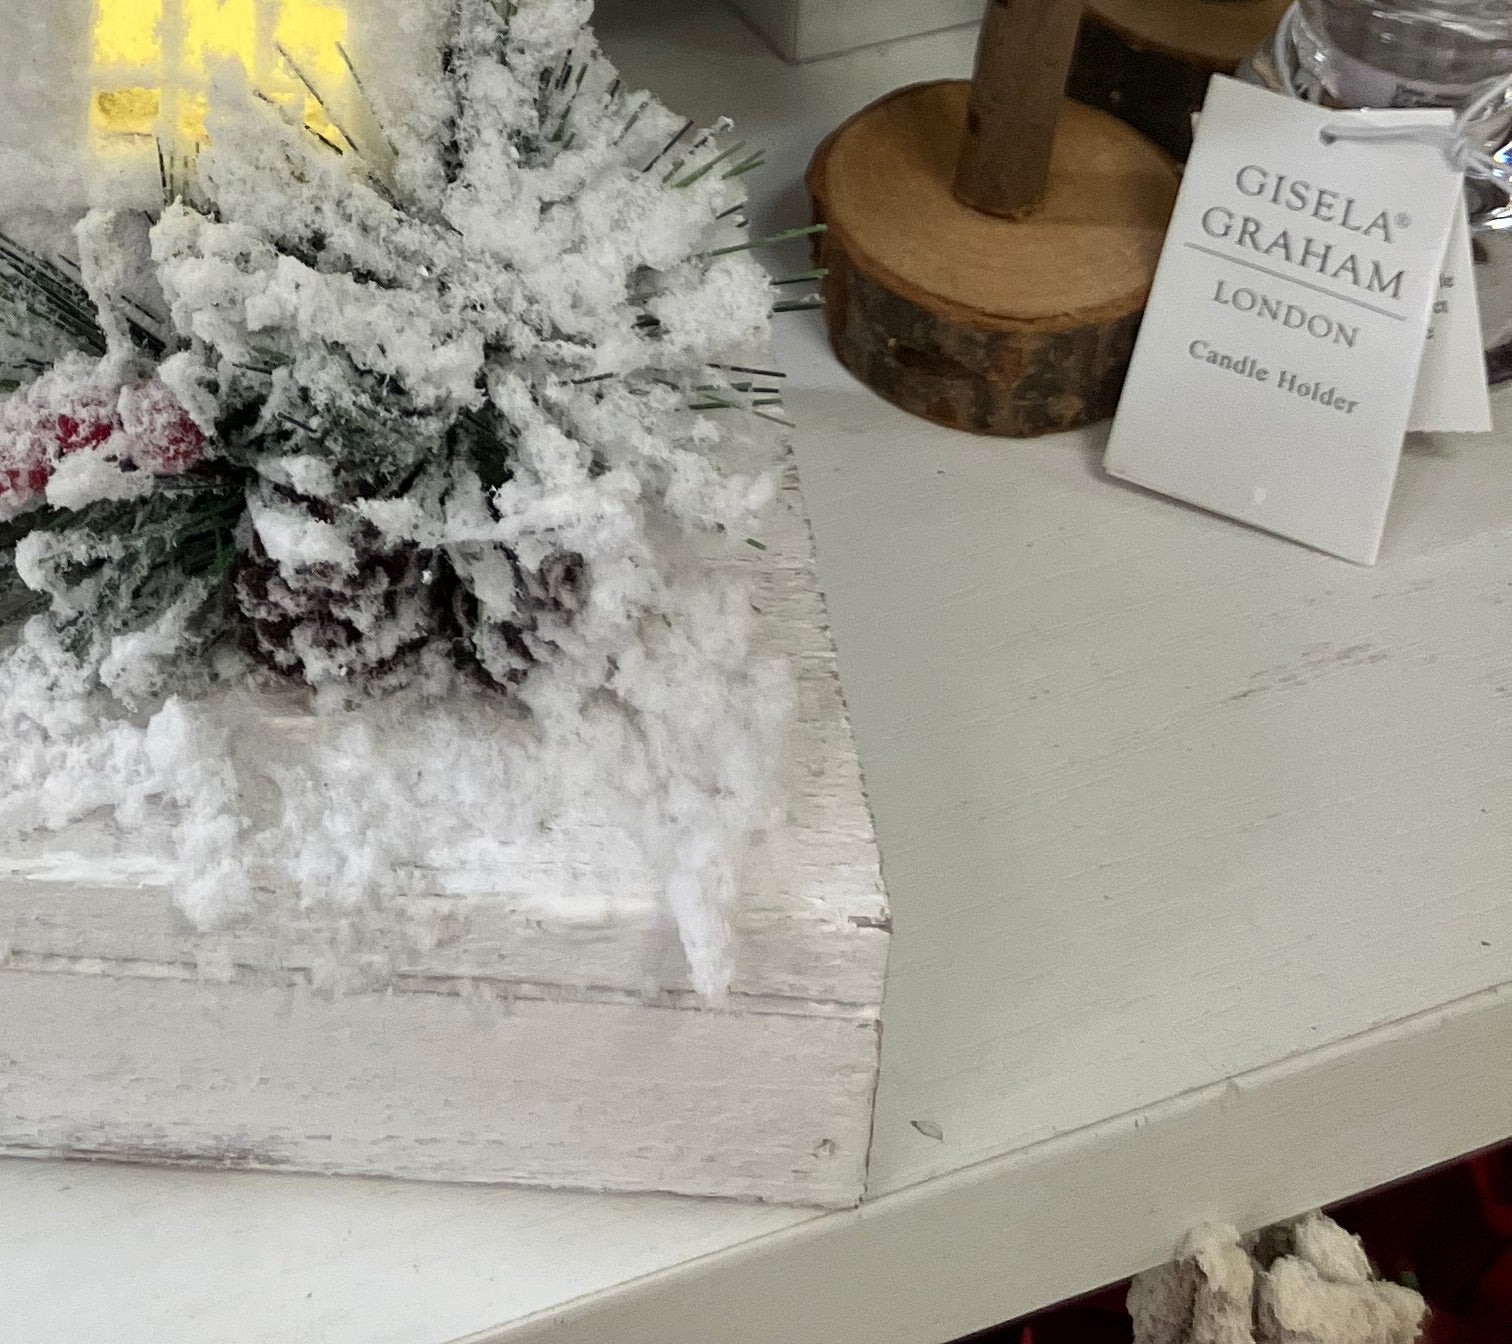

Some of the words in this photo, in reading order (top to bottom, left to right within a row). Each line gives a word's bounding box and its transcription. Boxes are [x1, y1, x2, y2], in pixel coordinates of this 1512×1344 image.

[1201, 206, 1405, 300] GRAHAM
[1212, 279, 1361, 348] LONDON
[1188, 339, 1269, 382] Candle
[1277, 370, 1360, 414] Holder
